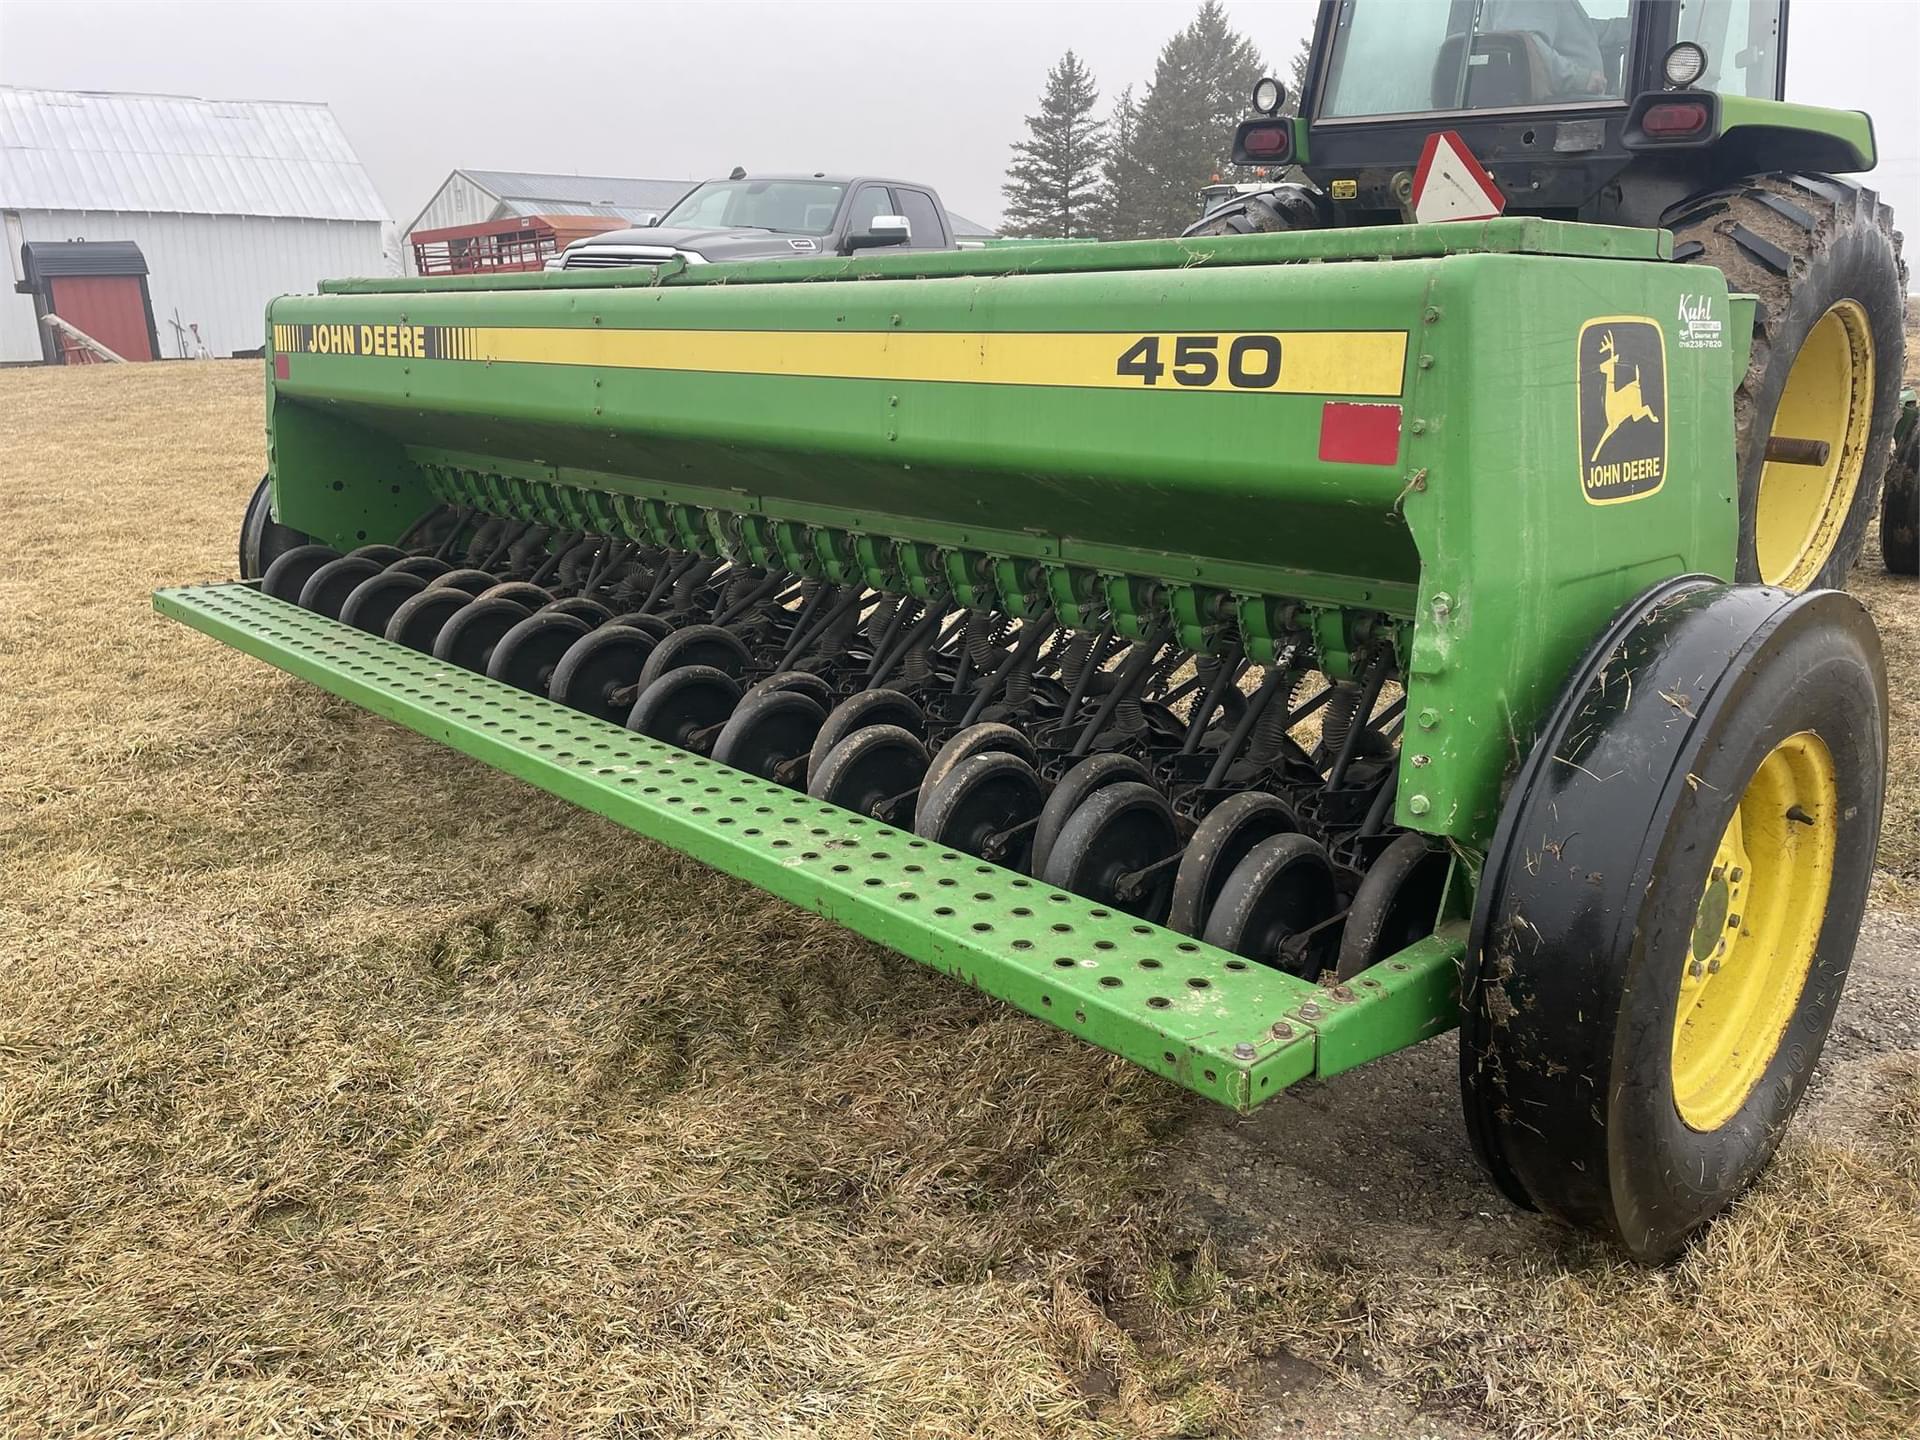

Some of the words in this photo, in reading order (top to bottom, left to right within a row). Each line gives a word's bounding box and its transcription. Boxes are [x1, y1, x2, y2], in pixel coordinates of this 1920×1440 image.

[1678, 293, 1712, 323] Kuhl
[308, 324, 355, 354] JOHN
[361, 325, 426, 357] DEERE
[1116, 335, 1282, 388] 450
[1587, 464, 1621, 489] JOHN
[1623, 457, 1660, 483] DEERE
